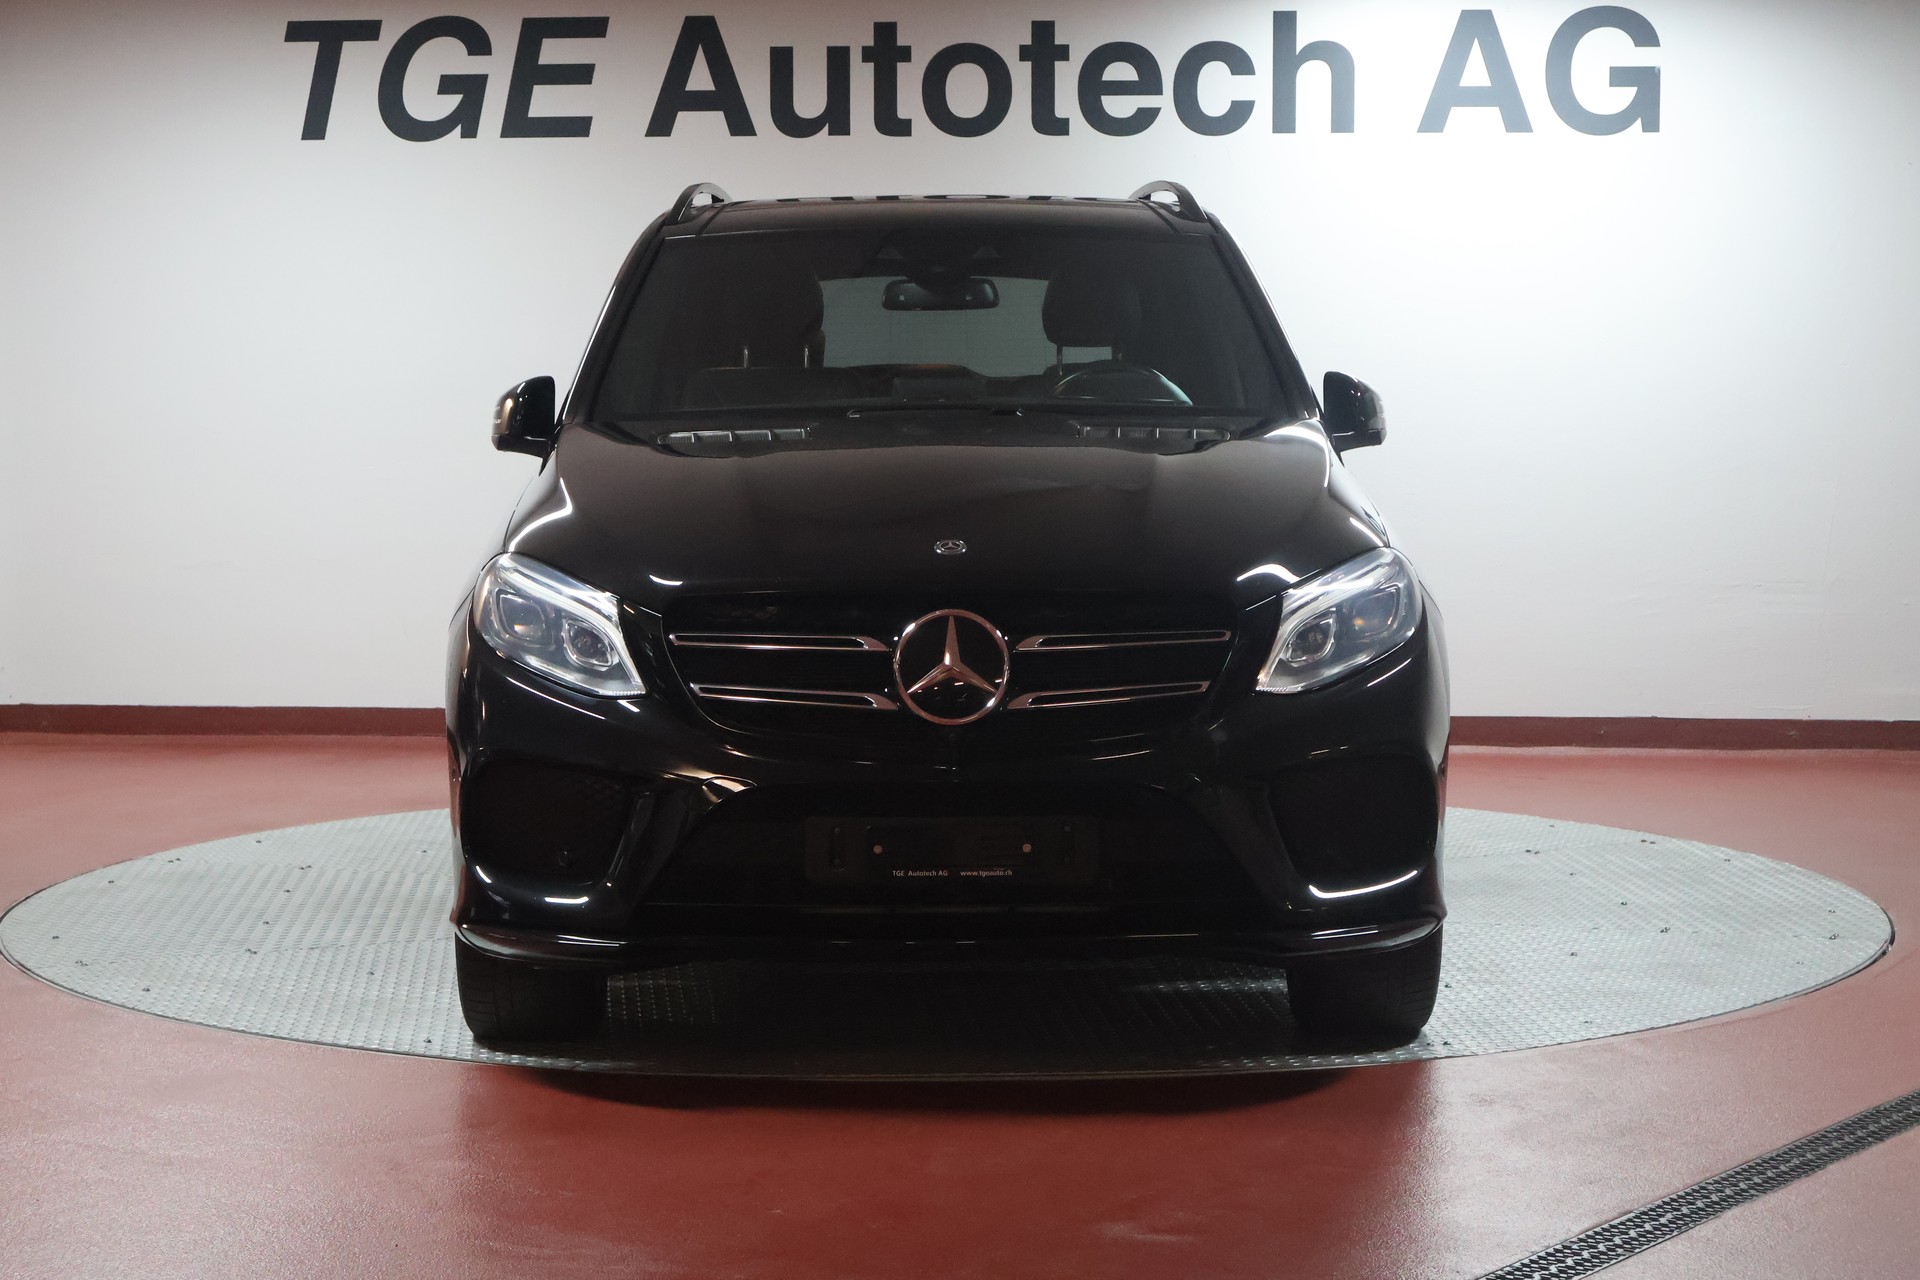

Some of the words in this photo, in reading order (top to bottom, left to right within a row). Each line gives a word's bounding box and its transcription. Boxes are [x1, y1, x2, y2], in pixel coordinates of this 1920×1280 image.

[284, 15, 610, 142] TGE
[644, 10, 1356, 138] Autotech
[1416, 6, 1662, 136] AG
[960, 869, 1013, 878] www.tgeauto.ch
